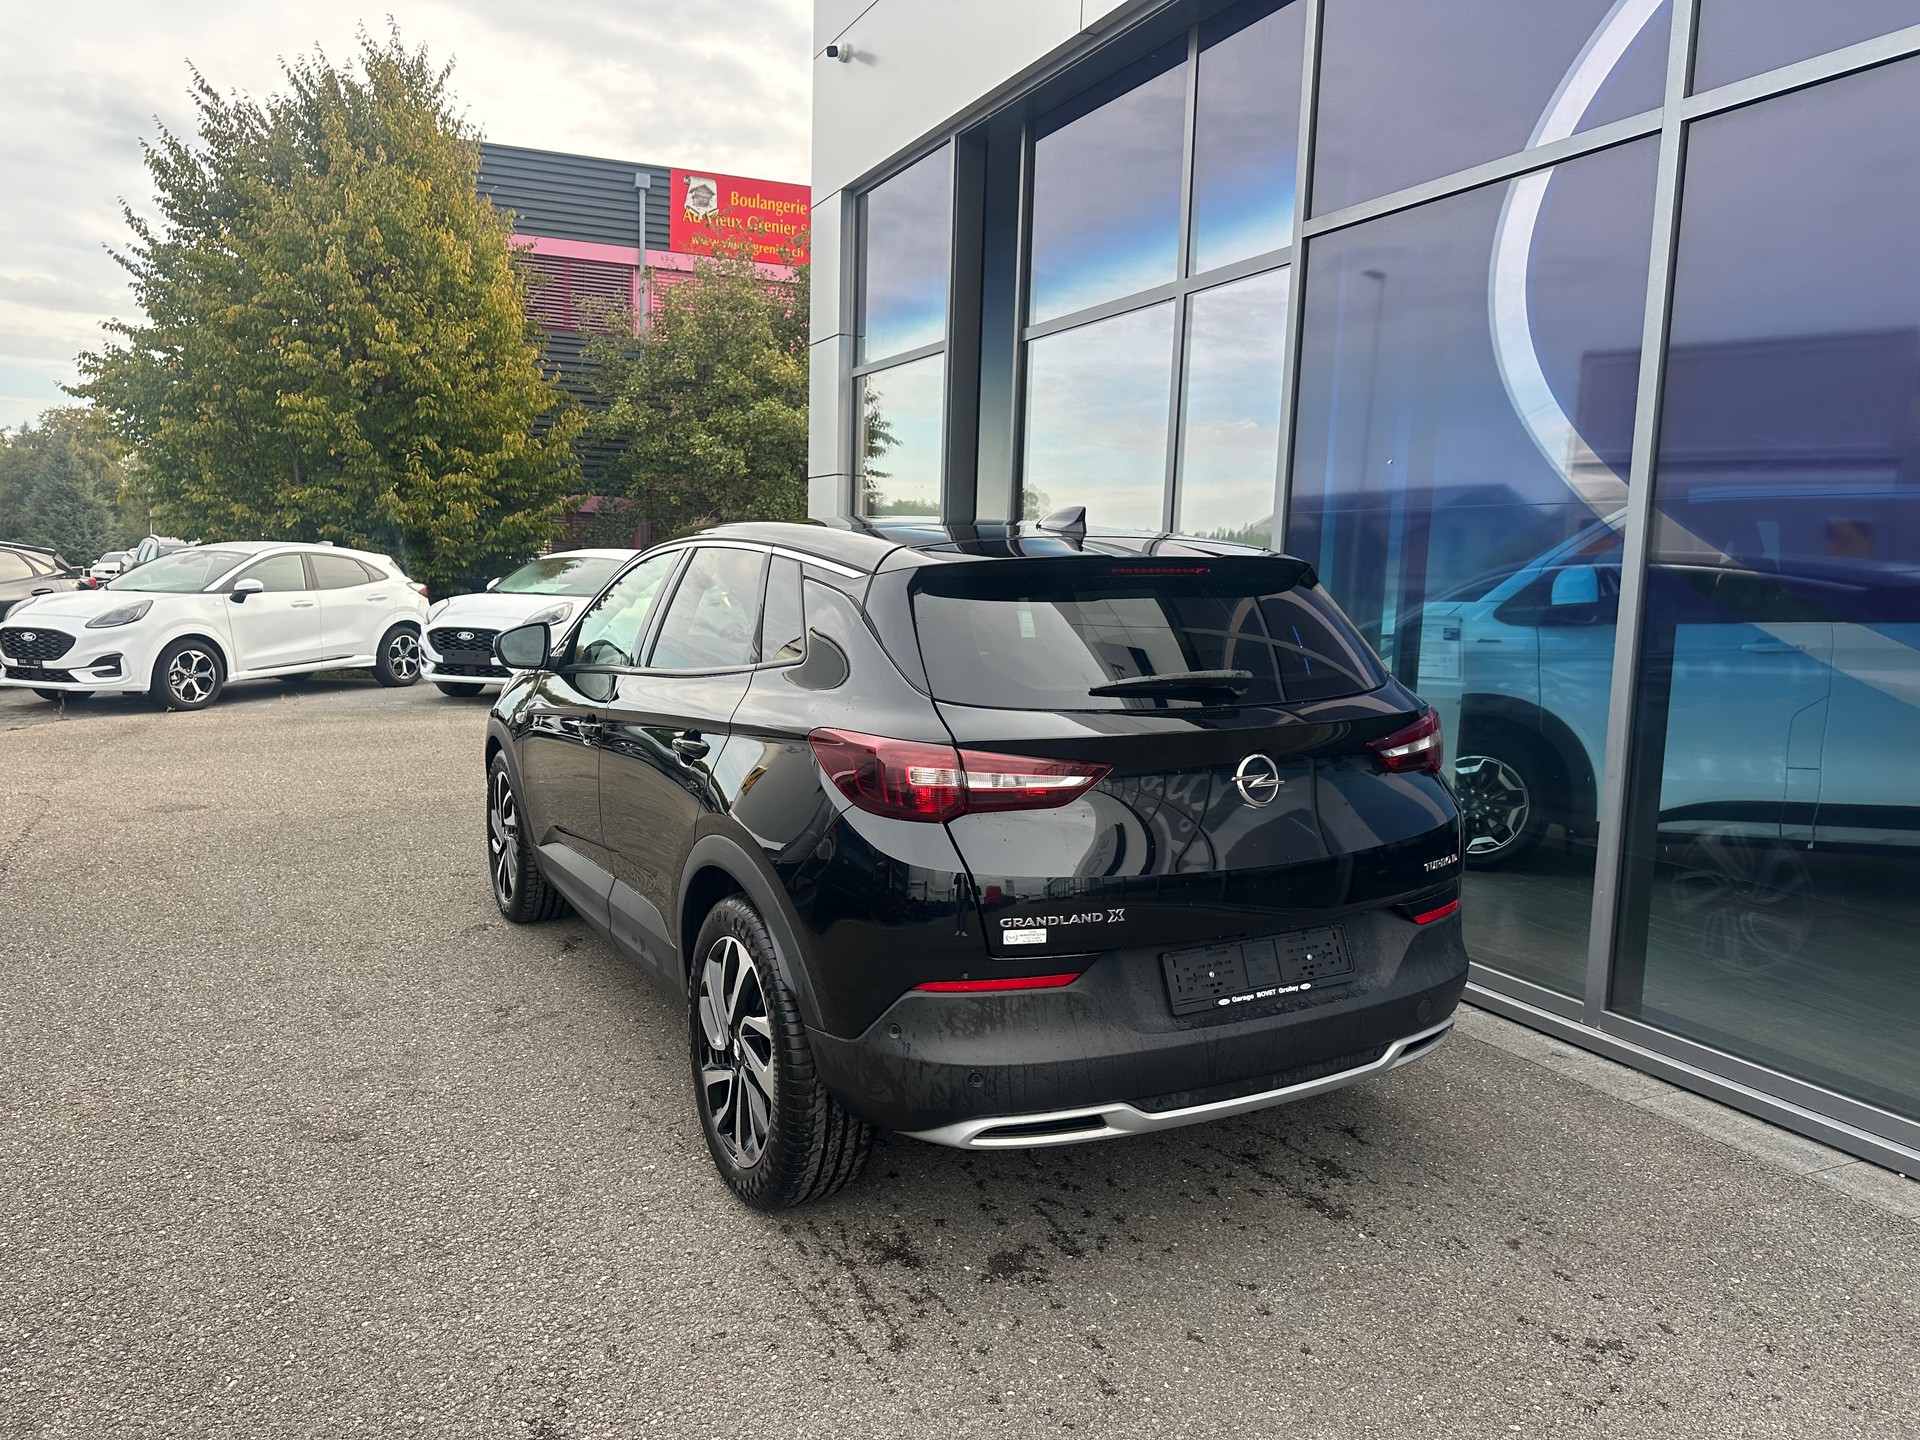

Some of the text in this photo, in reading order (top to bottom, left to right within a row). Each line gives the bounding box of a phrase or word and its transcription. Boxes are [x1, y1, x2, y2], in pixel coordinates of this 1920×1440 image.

[730, 191, 808, 216] Boulangerie
[682, 208, 701, 224] Au
[1000, 908, 1125, 928] GRANDLAND X
[1256, 989, 1277, 998] BOVET
